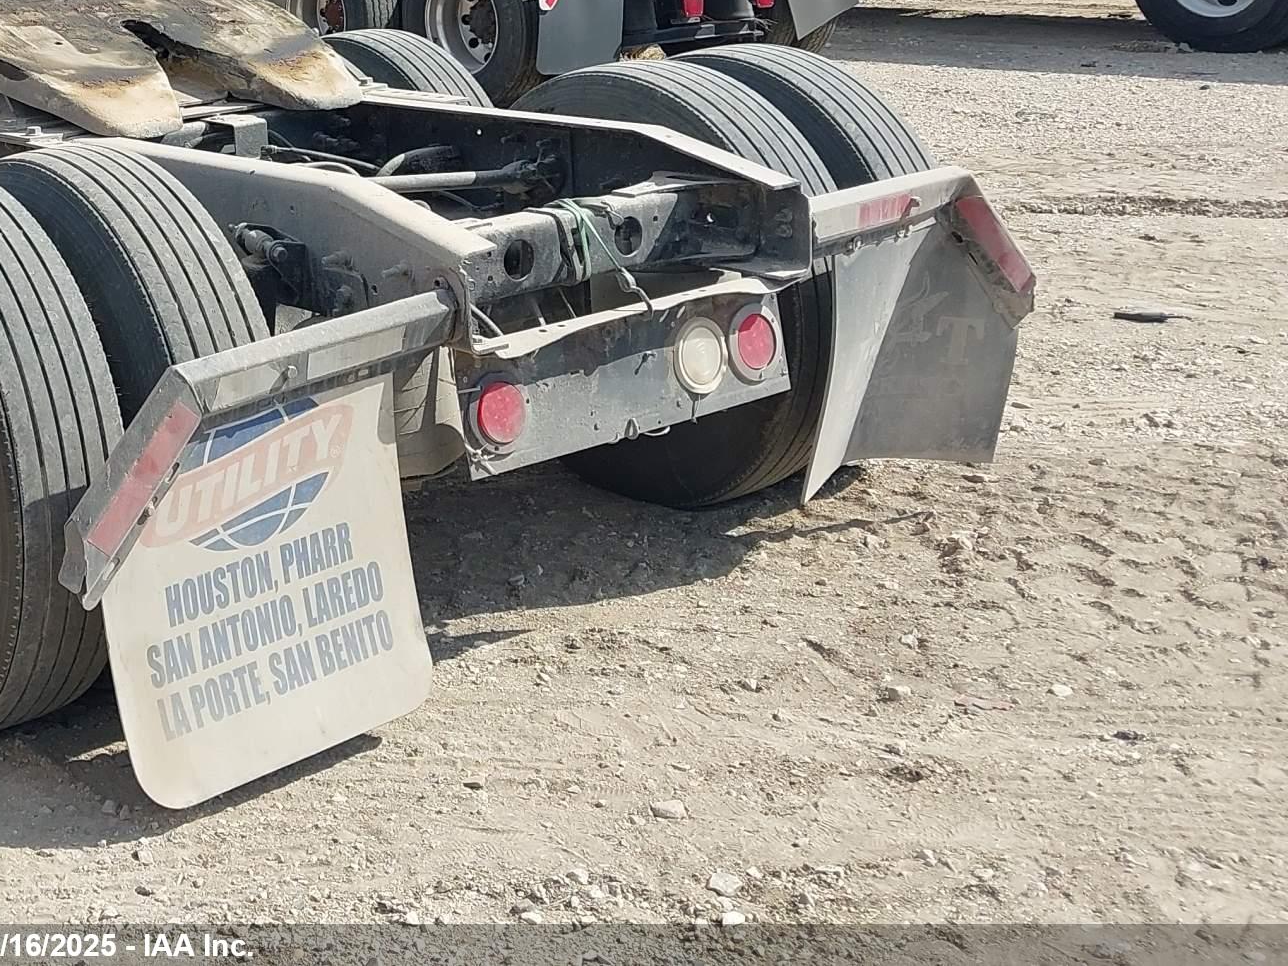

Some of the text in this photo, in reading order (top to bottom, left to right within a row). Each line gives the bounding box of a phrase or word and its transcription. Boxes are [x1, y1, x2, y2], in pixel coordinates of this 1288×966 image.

[163, 415, 341, 531] UTILITY
[147, 561, 385, 690] SAN ANTONIO, LAREDO
[165, 521, 354, 628] HOUSTON, PHARR
[157, 609, 395, 743] LA PORTE, SAN BENITO
